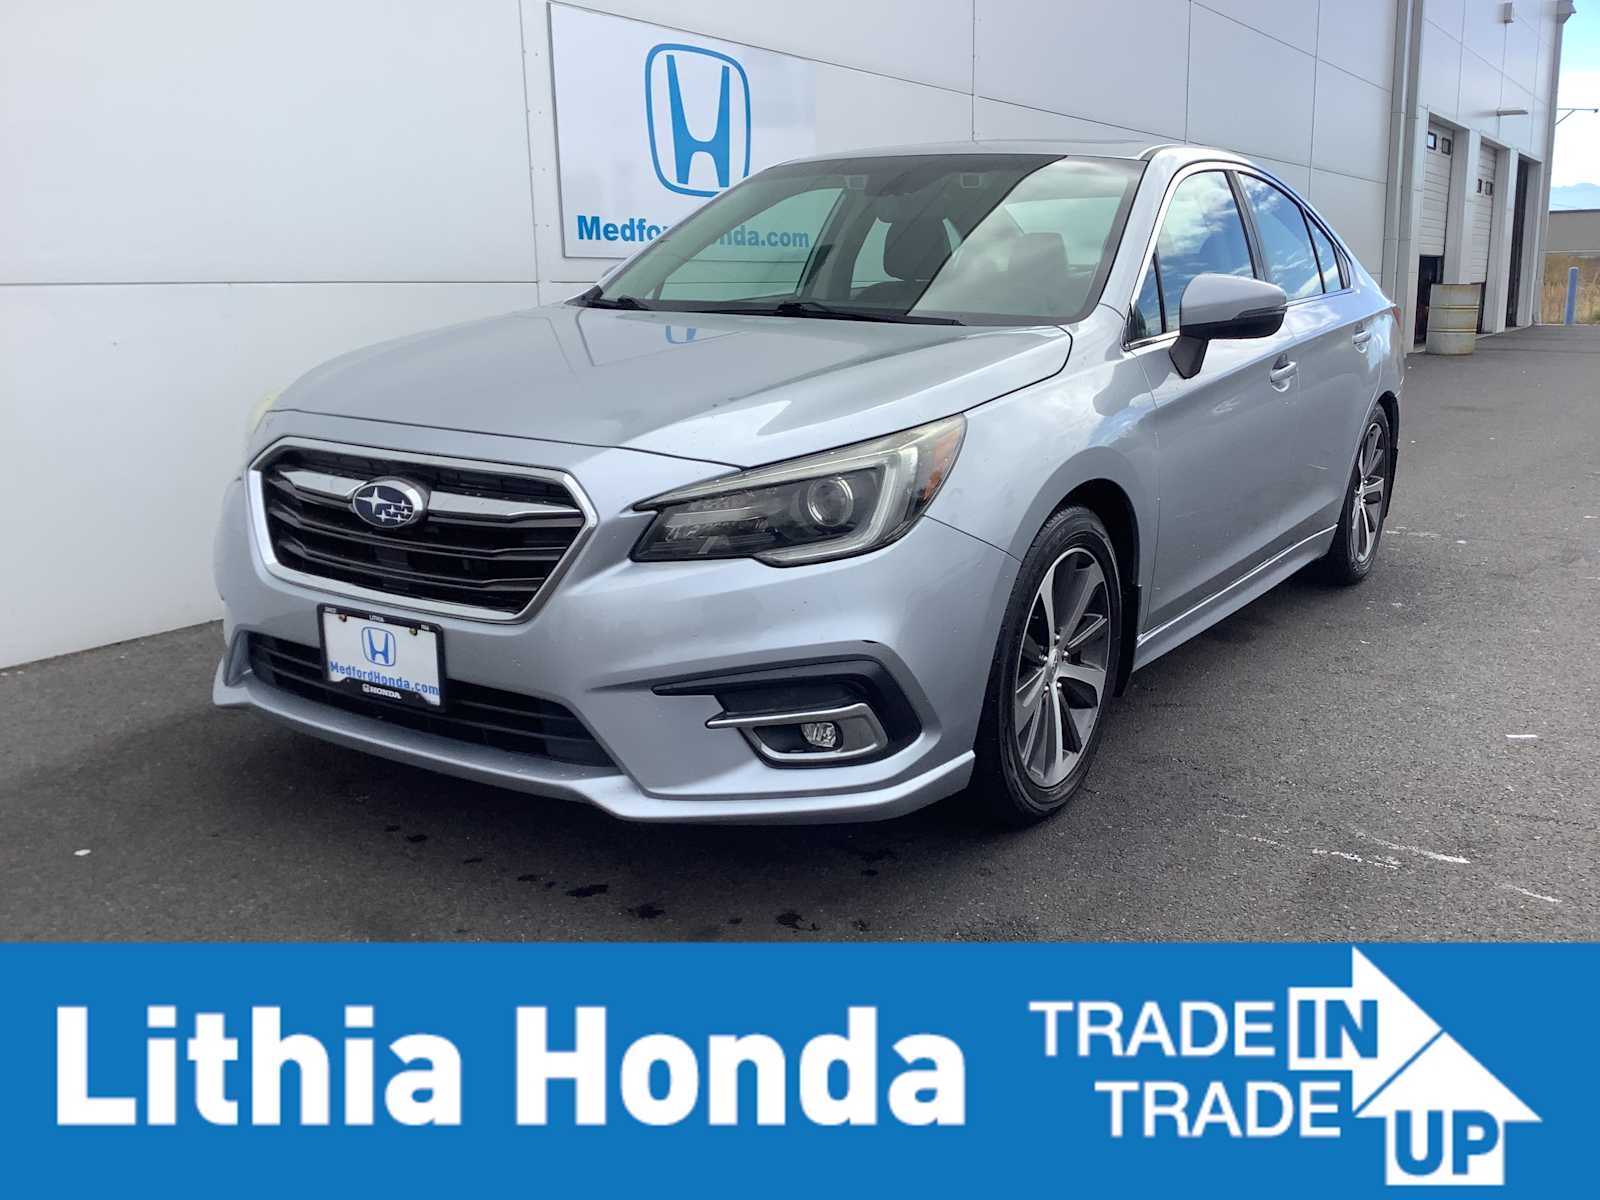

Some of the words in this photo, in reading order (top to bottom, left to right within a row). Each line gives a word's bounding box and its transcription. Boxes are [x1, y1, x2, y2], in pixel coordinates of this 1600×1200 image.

[577, 214, 809, 248] Medfonda.com
[330, 661, 440, 695] MedfordHonda.com
[370, 686, 402, 699] HONDA
